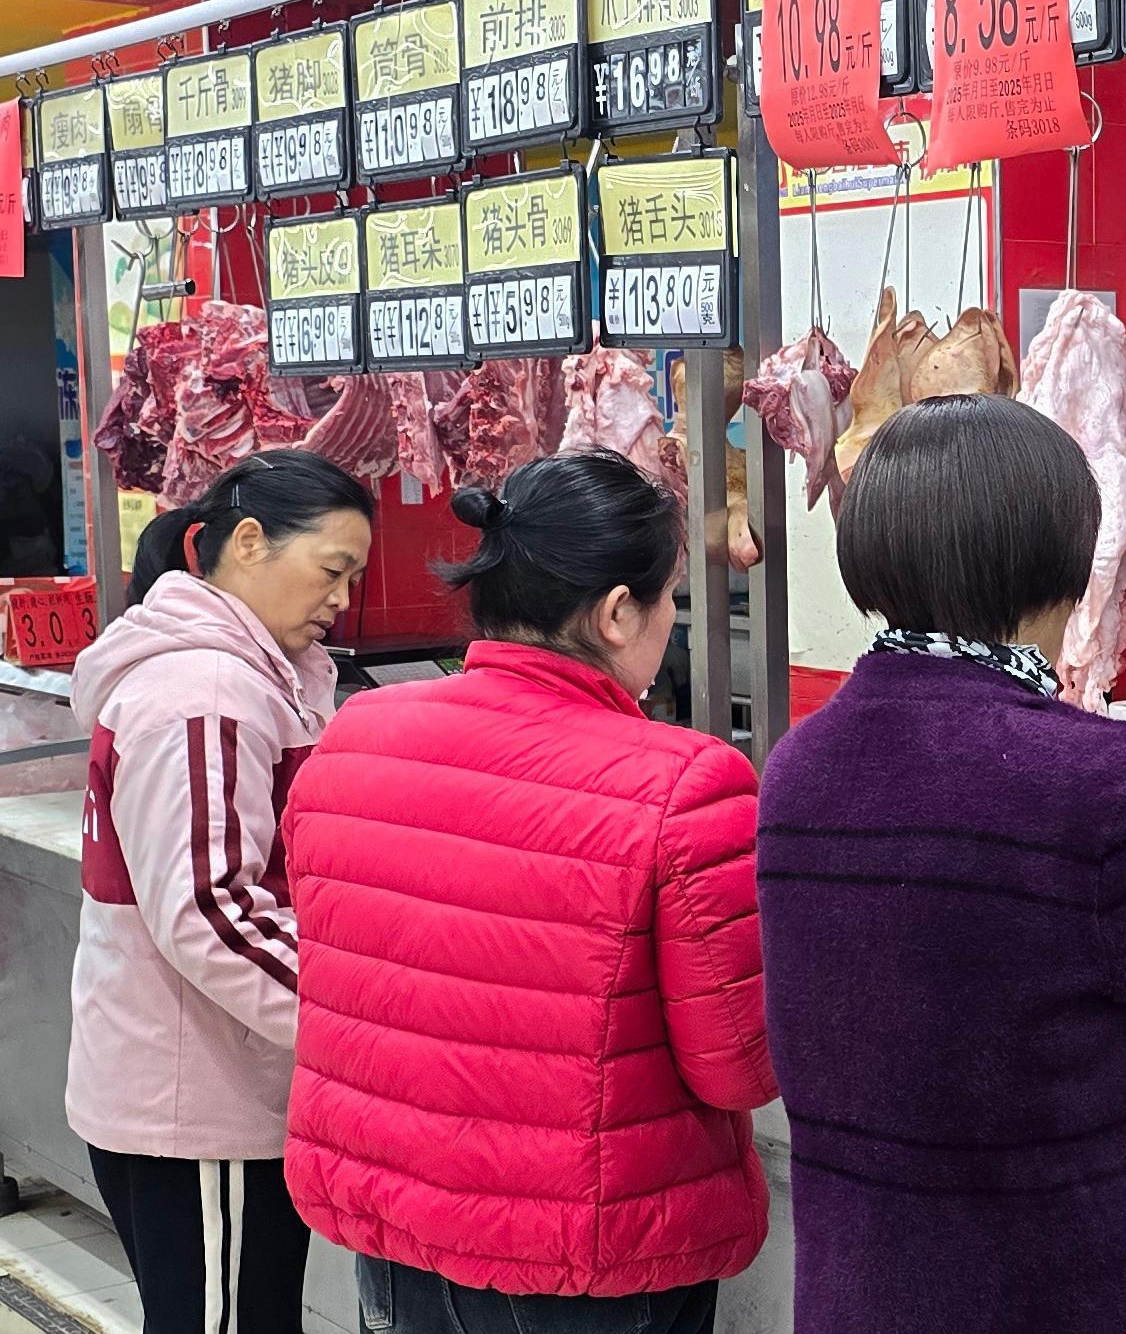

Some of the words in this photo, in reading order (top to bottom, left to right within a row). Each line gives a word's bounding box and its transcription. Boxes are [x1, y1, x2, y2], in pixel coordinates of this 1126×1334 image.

[269, 59, 321, 104] 猪脚
[50, 110, 87, 150] 瘦肉
[1006, 117, 1061, 140] 条码3018
[482, 195, 549, 256] 猪头骨
[619, 191, 697, 247] 猪舌头
[700, 210, 723, 241] 3015
[379, 225, 442, 275] 猪耳朵
